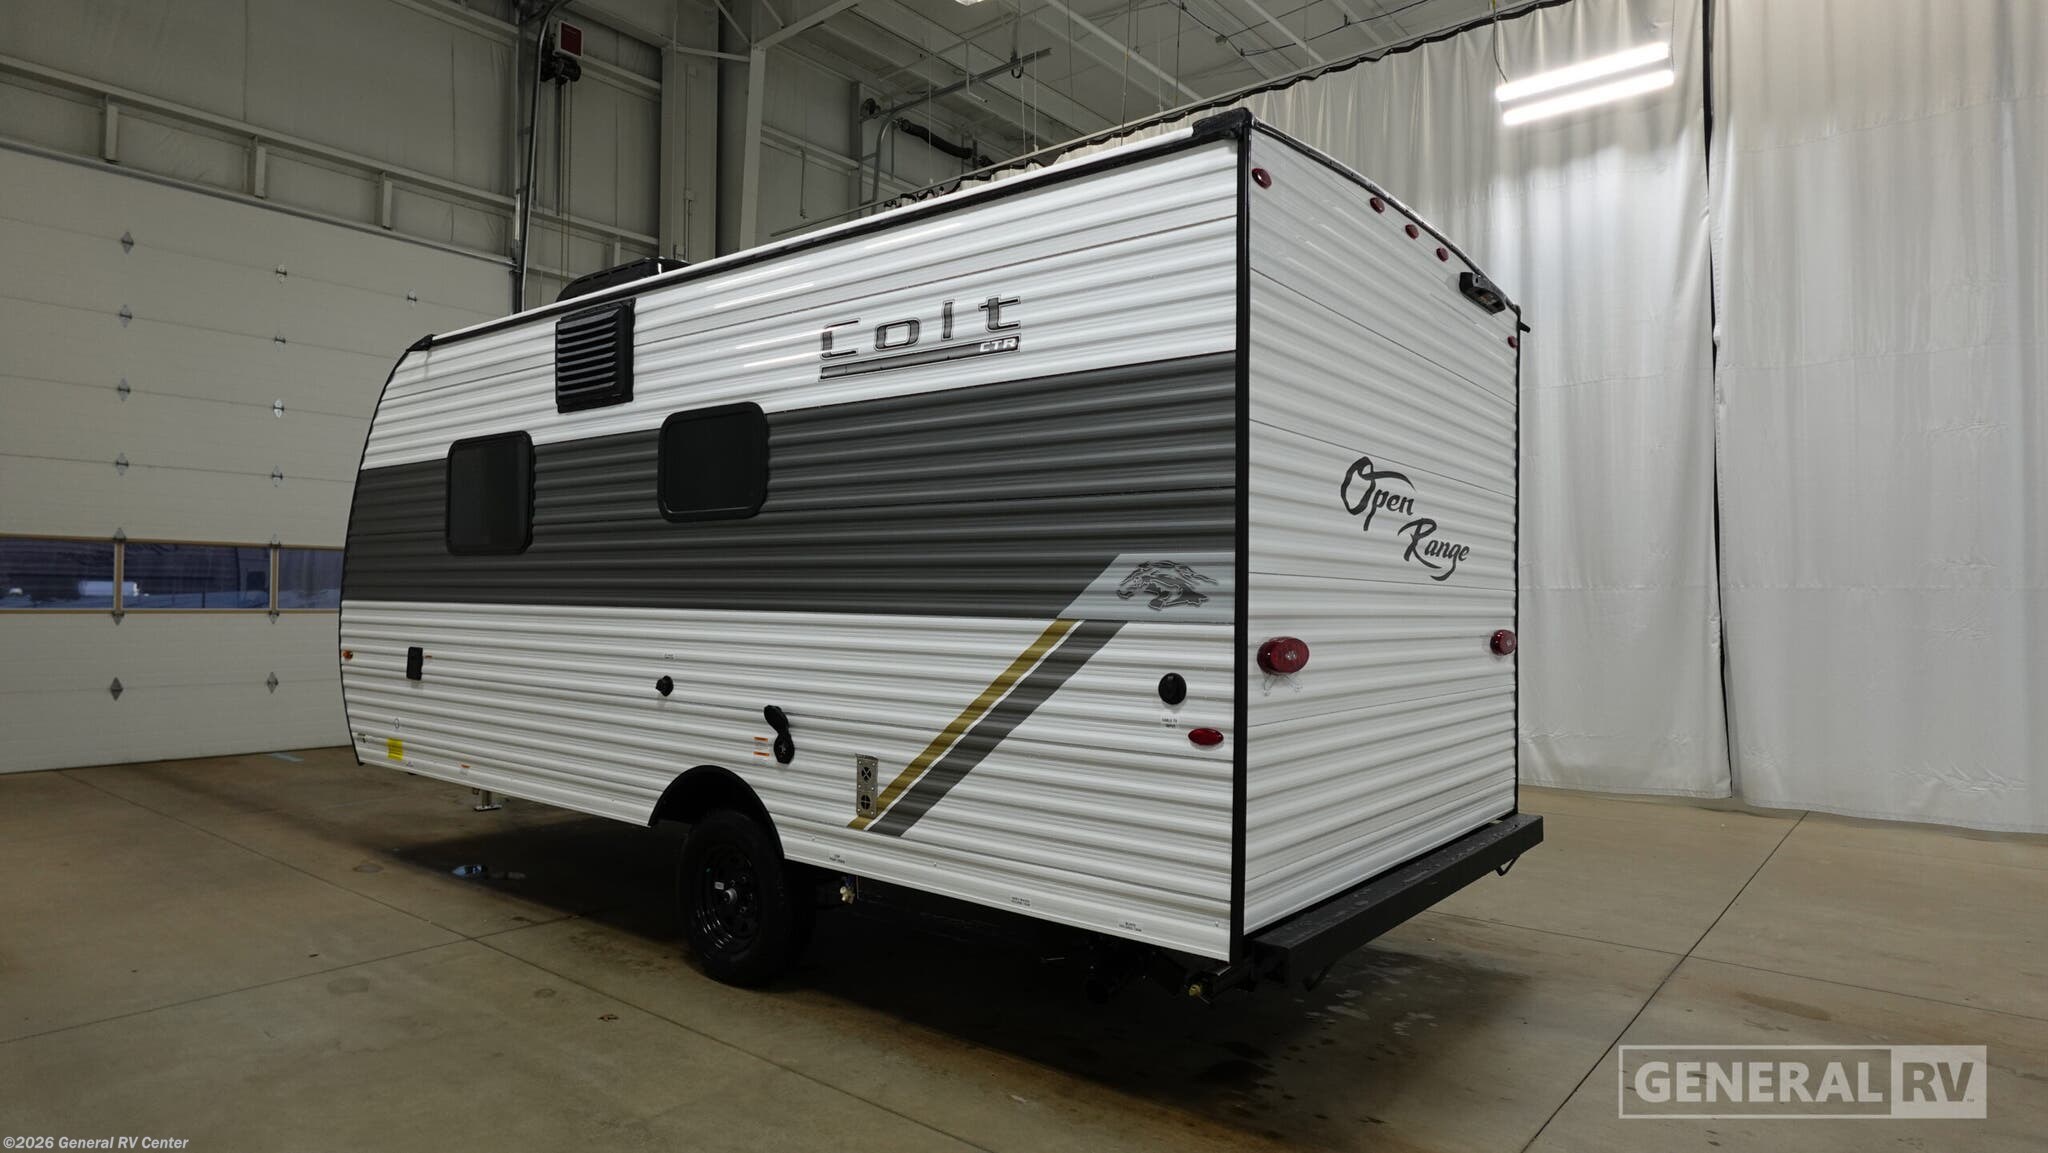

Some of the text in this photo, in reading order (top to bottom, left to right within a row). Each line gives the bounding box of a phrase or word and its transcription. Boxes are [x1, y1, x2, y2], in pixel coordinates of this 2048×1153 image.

[820, 296, 1021, 359] Colt
[979, 337, 1018, 353] CTR
[1340, 456, 1416, 532] Open
[1397, 517, 1471, 582] Range
